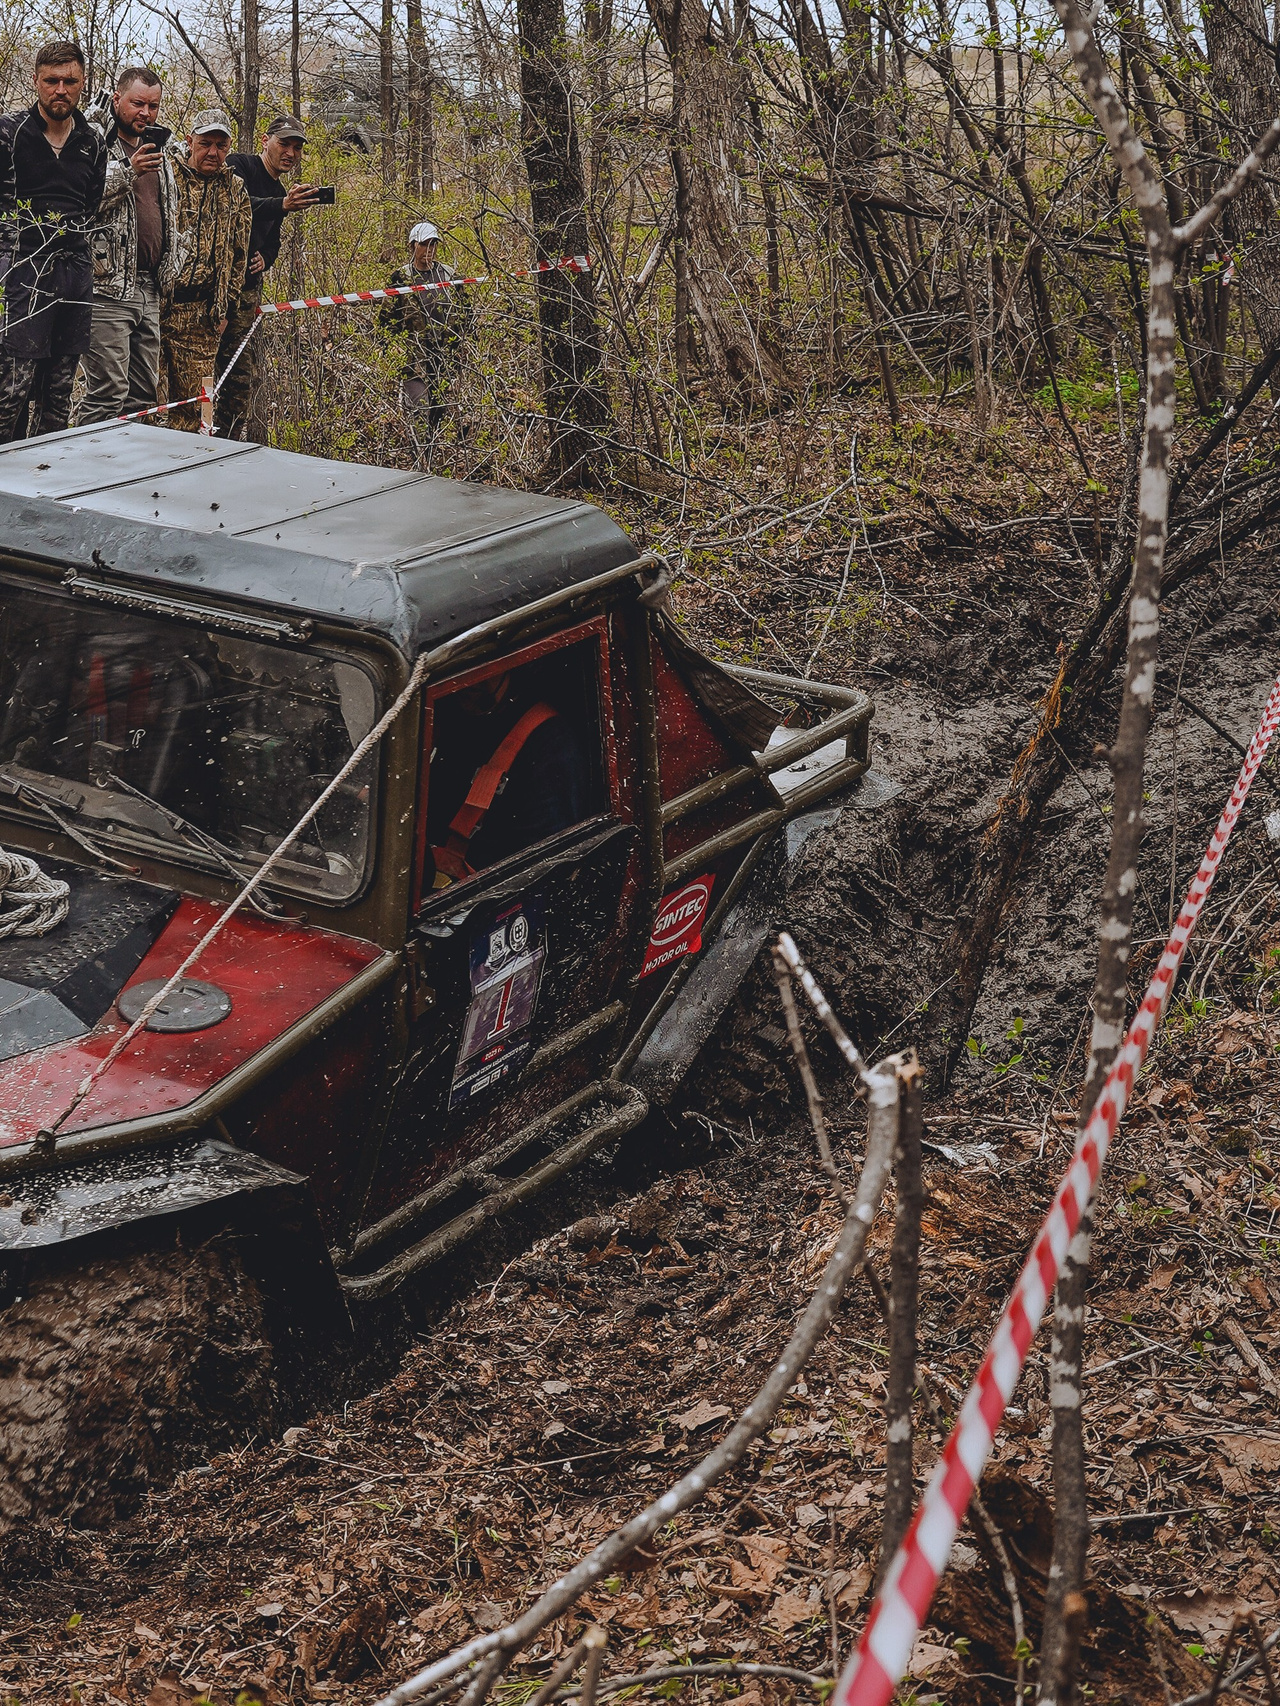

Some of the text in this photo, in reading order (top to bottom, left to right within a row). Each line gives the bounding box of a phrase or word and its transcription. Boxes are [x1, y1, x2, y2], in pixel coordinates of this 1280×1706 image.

[653, 894, 705, 936] SINTEC
[644, 941, 689, 973] MOTOR OIL
[487, 975, 516, 1040] 1
